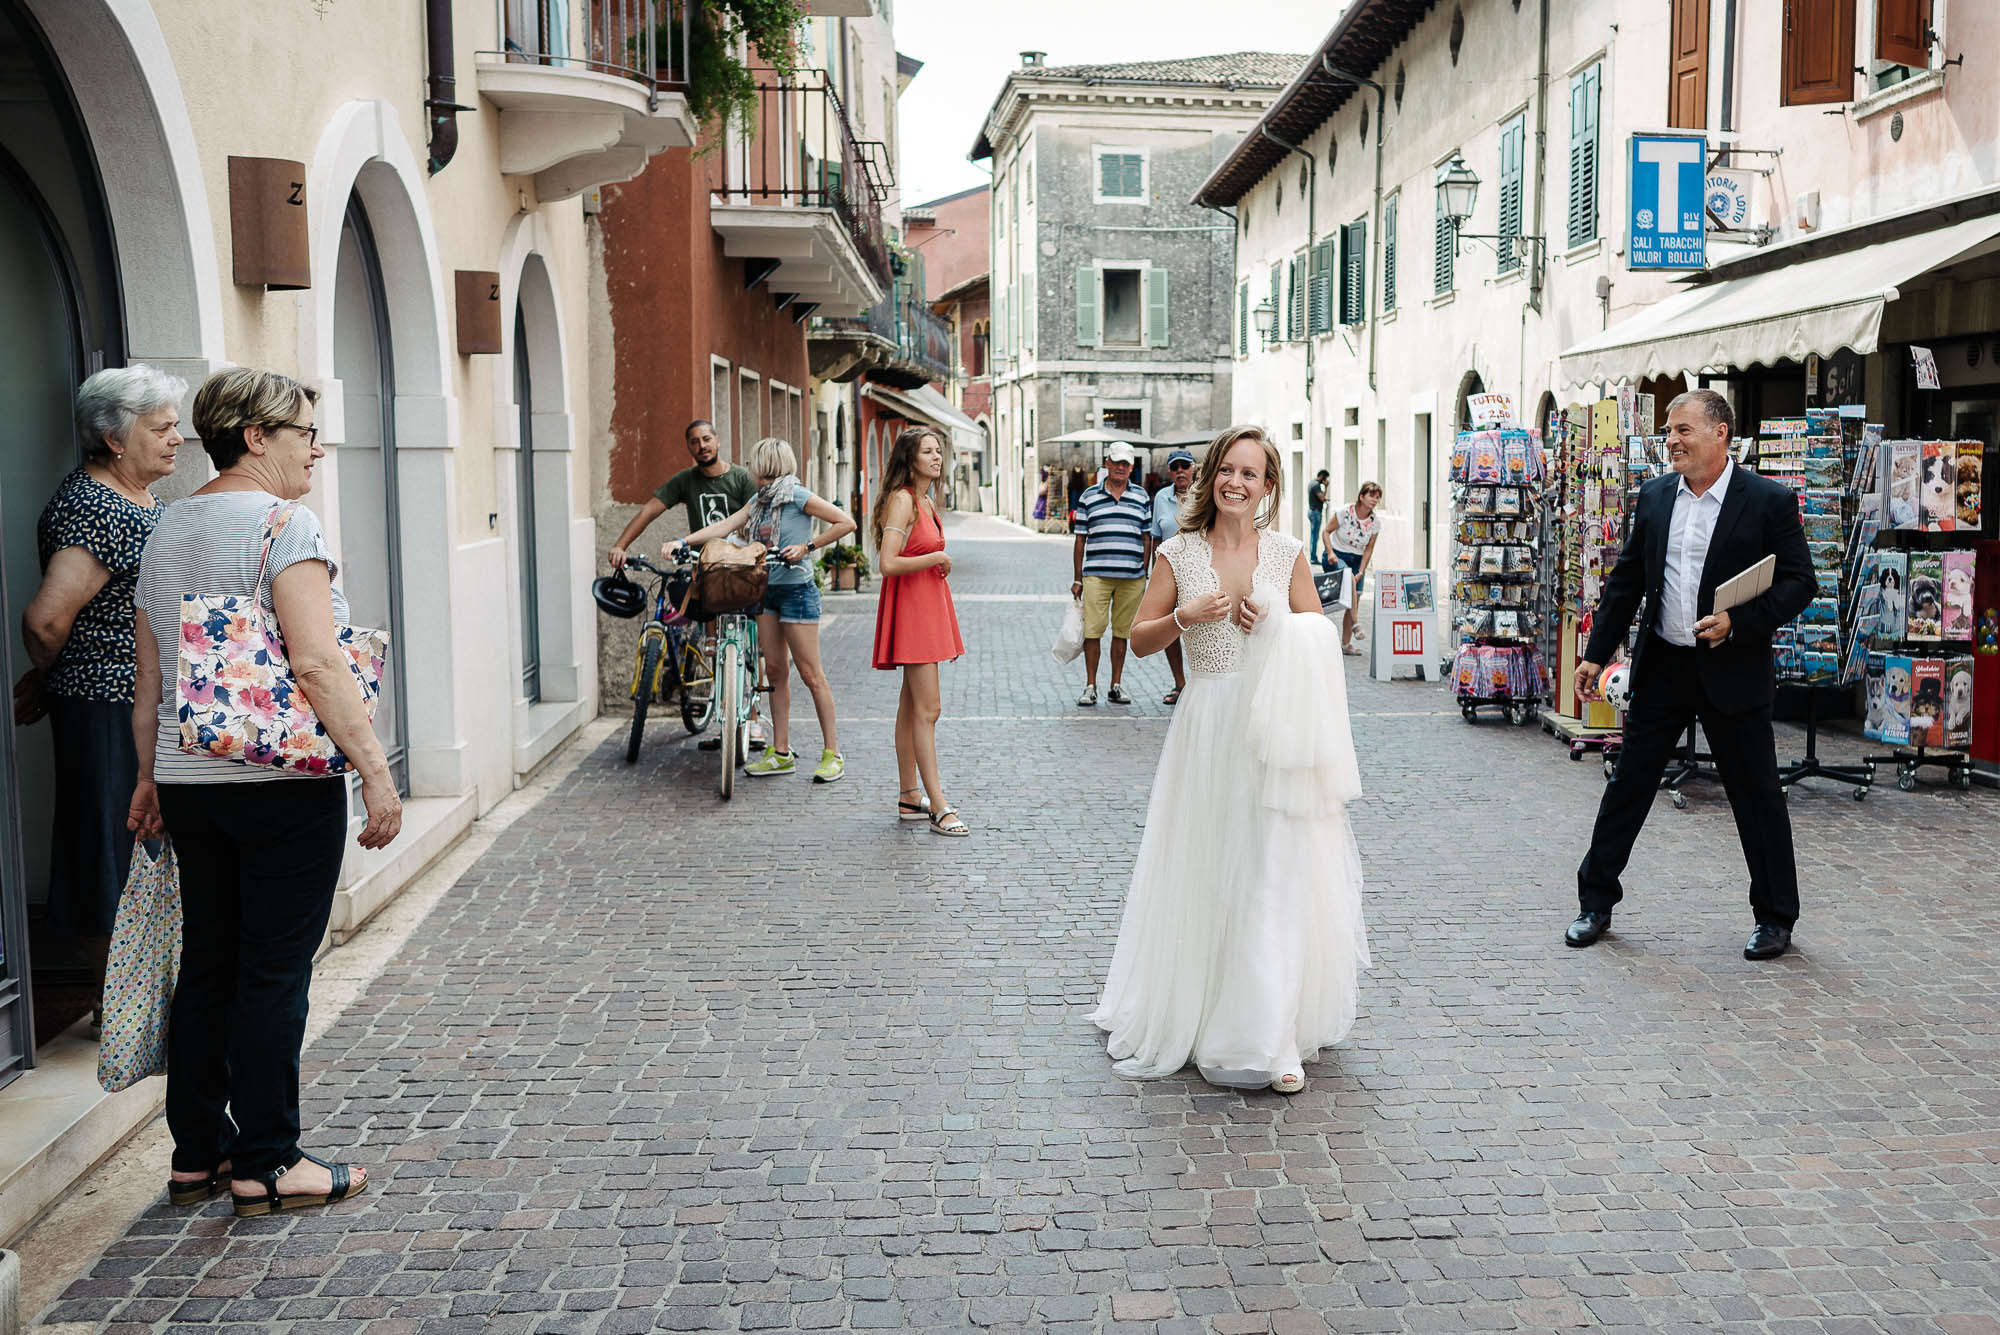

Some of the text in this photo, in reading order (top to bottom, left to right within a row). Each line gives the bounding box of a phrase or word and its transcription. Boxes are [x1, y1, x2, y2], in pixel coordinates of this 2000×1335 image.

[1638, 141, 1700, 233] T
[1706, 176, 1746, 224] ITORIA LOTTO
[1632, 236, 1702, 250] SALI TABACCHI
[1632, 250, 1702, 264] VALORI BOLLATI
[1472, 394, 1511, 406] TUTTO A
[1394, 623, 1421, 652] Bild
